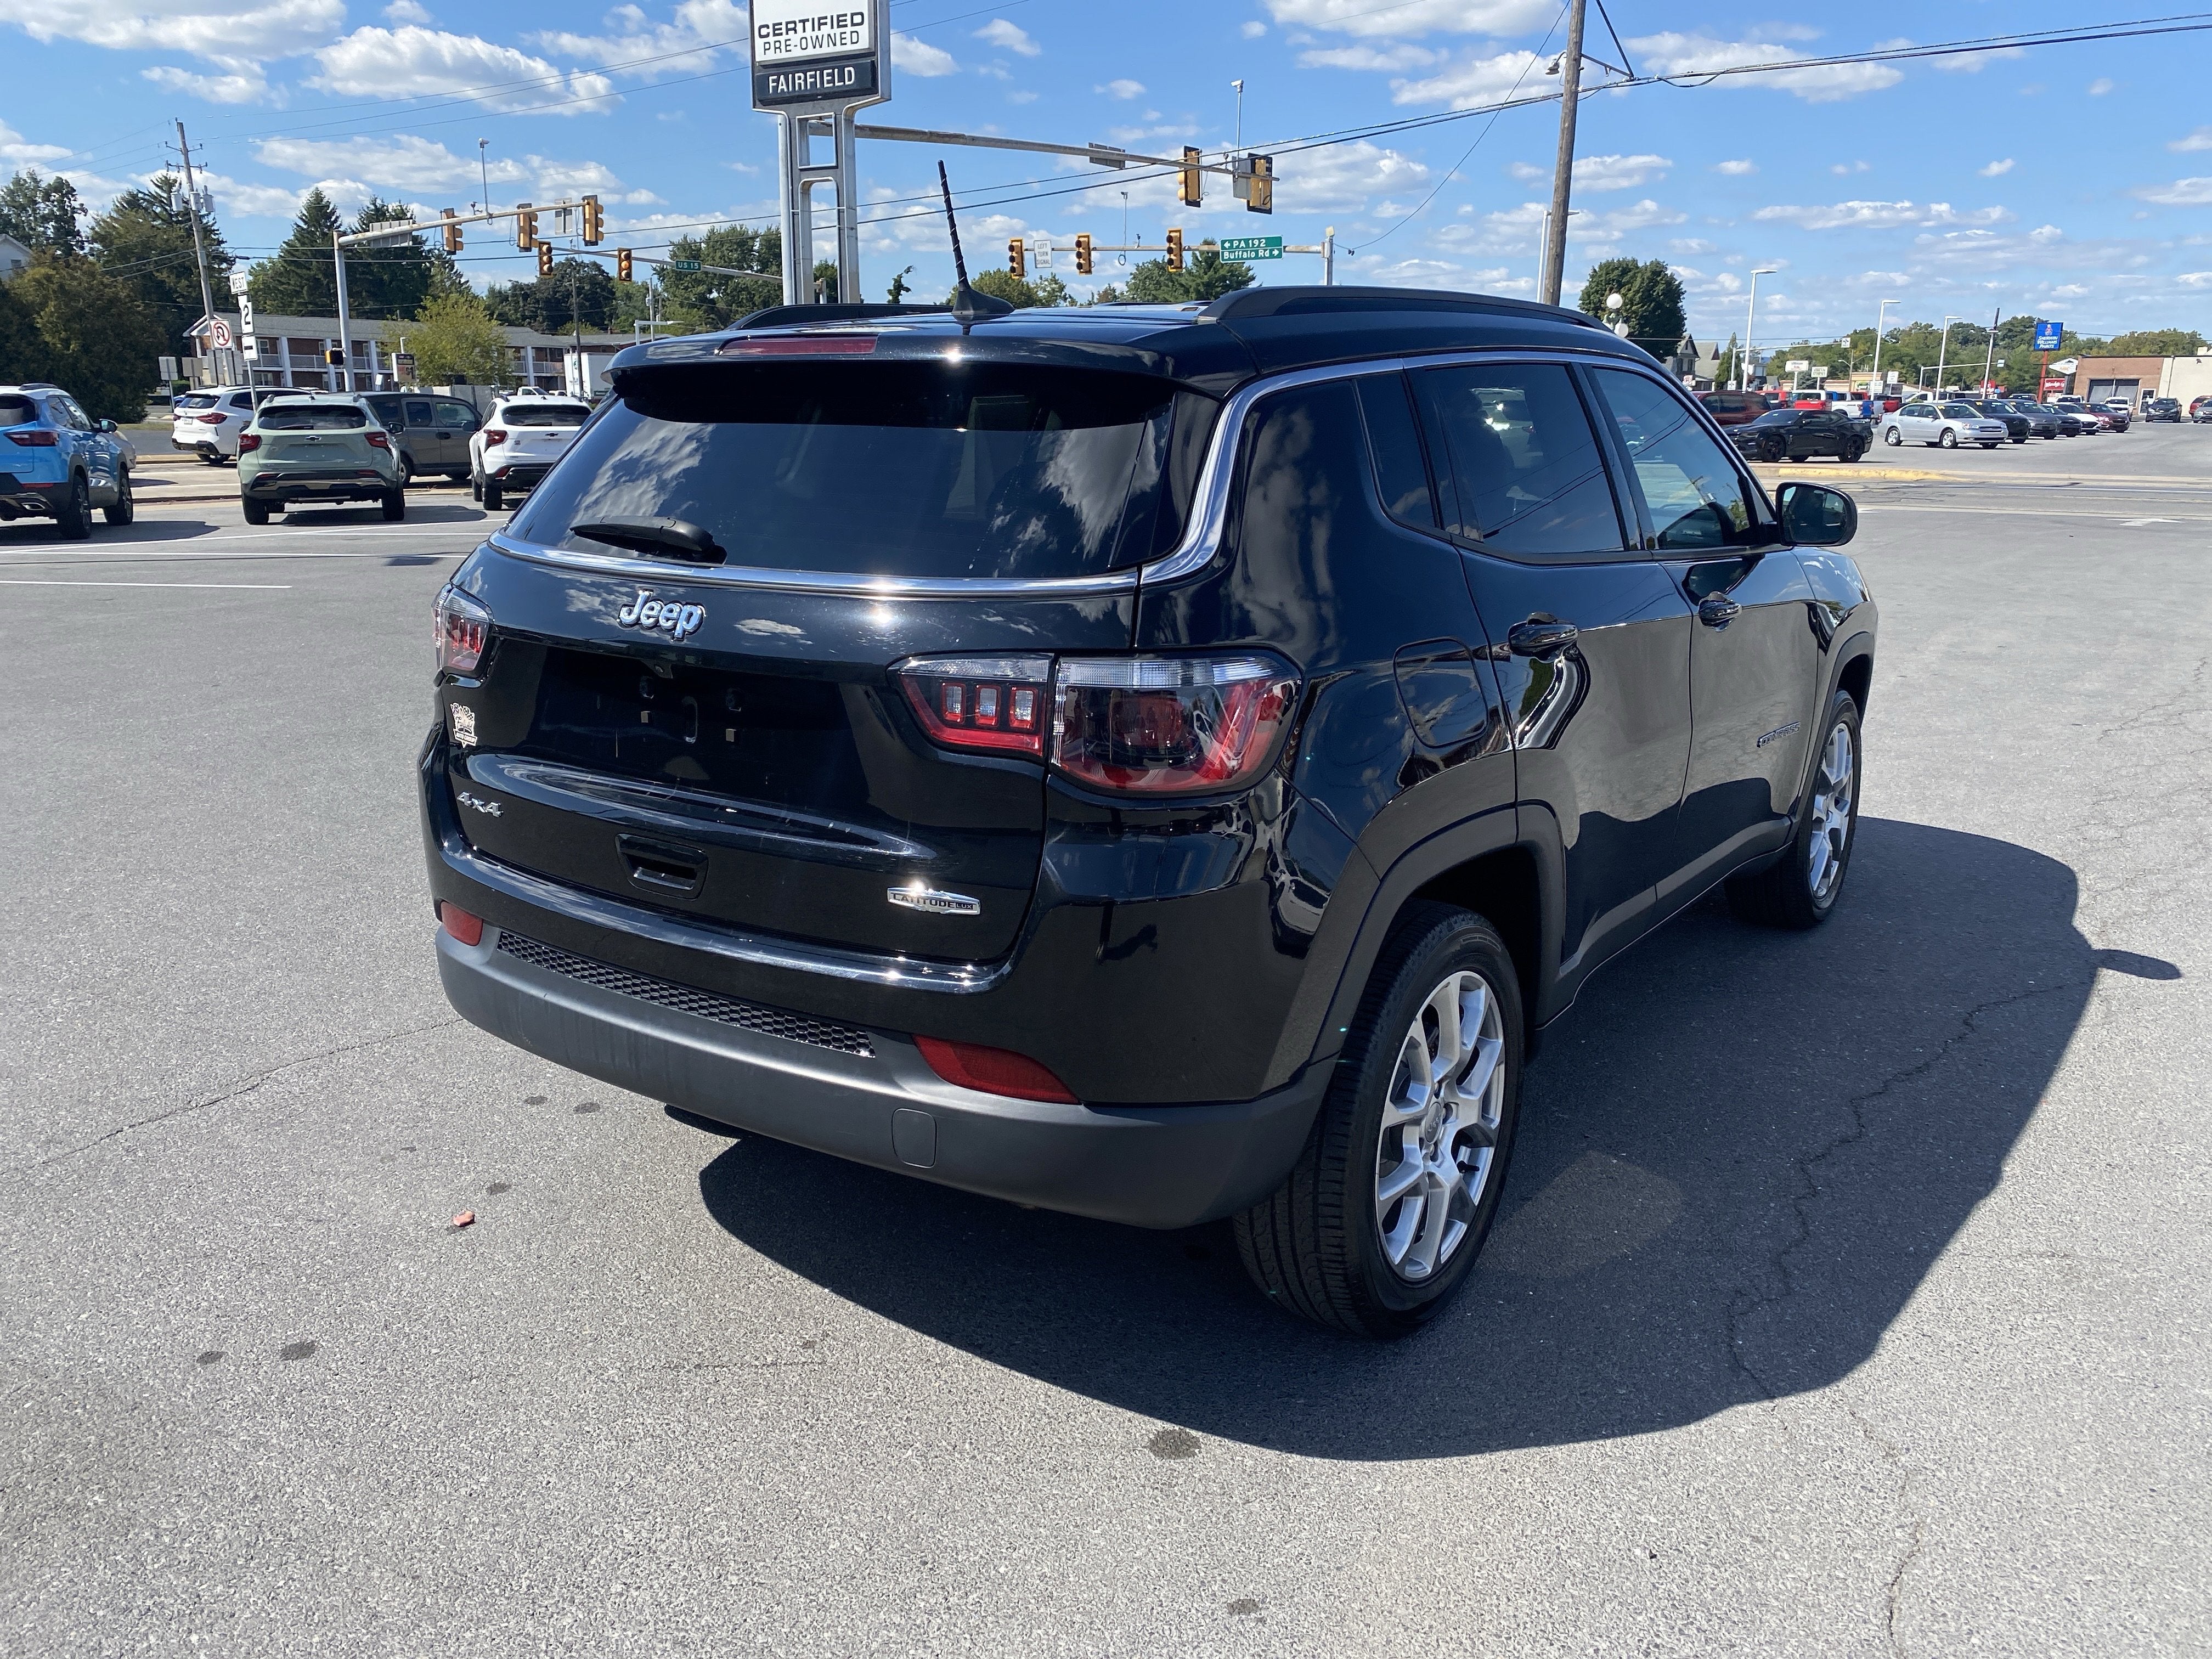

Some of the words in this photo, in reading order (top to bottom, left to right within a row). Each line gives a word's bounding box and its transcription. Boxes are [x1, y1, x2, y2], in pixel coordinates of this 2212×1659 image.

[758, 12, 865, 38] CERTIFIED
[764, 30, 859, 55] PRE-OWNED
[769, 66, 855, 94] FAIRFIELD
[1223, 250, 1255, 259] Buffalo
[1259, 249, 1269, 257] Rd
[1233, 240, 1245, 249] PA
[1249, 239, 1266, 247] 192
[232, 276, 245, 290] WEST
[618, 590, 705, 640] Jeep
[893, 893, 956, 909] LATITUDE
